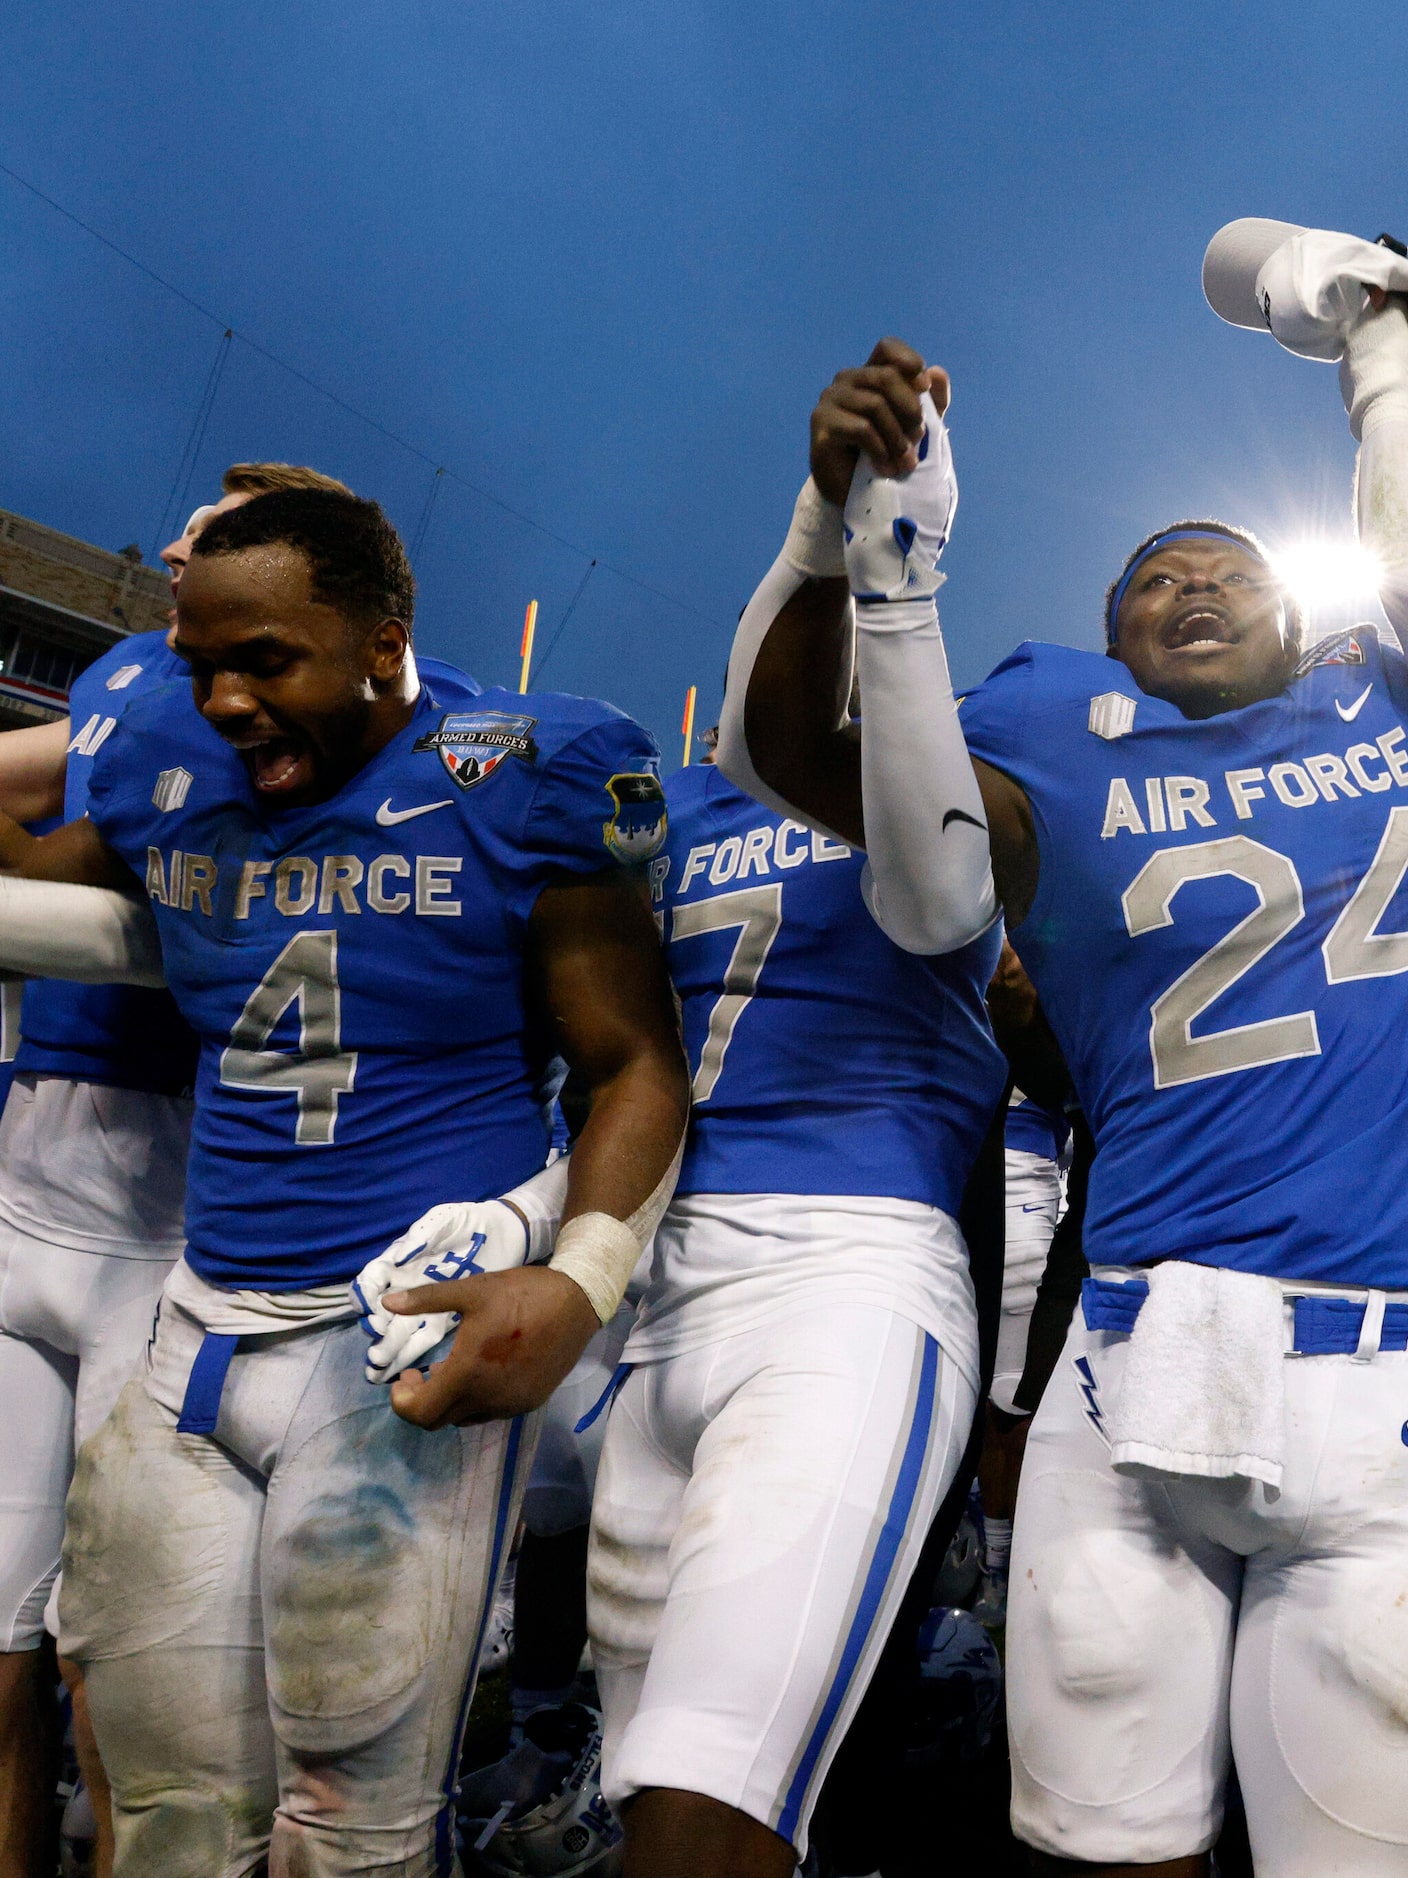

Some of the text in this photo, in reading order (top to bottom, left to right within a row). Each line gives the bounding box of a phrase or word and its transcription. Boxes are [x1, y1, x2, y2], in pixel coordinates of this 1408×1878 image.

[66, 714, 116, 756] AI
[429, 733, 528, 750] ARMED FORCES
[1101, 776, 1217, 837] AIR
[147, 846, 463, 919] AIR FORCE
[679, 818, 851, 895] FORCE
[654, 883, 783, 1105] 7
[220, 930, 358, 1145] 4
